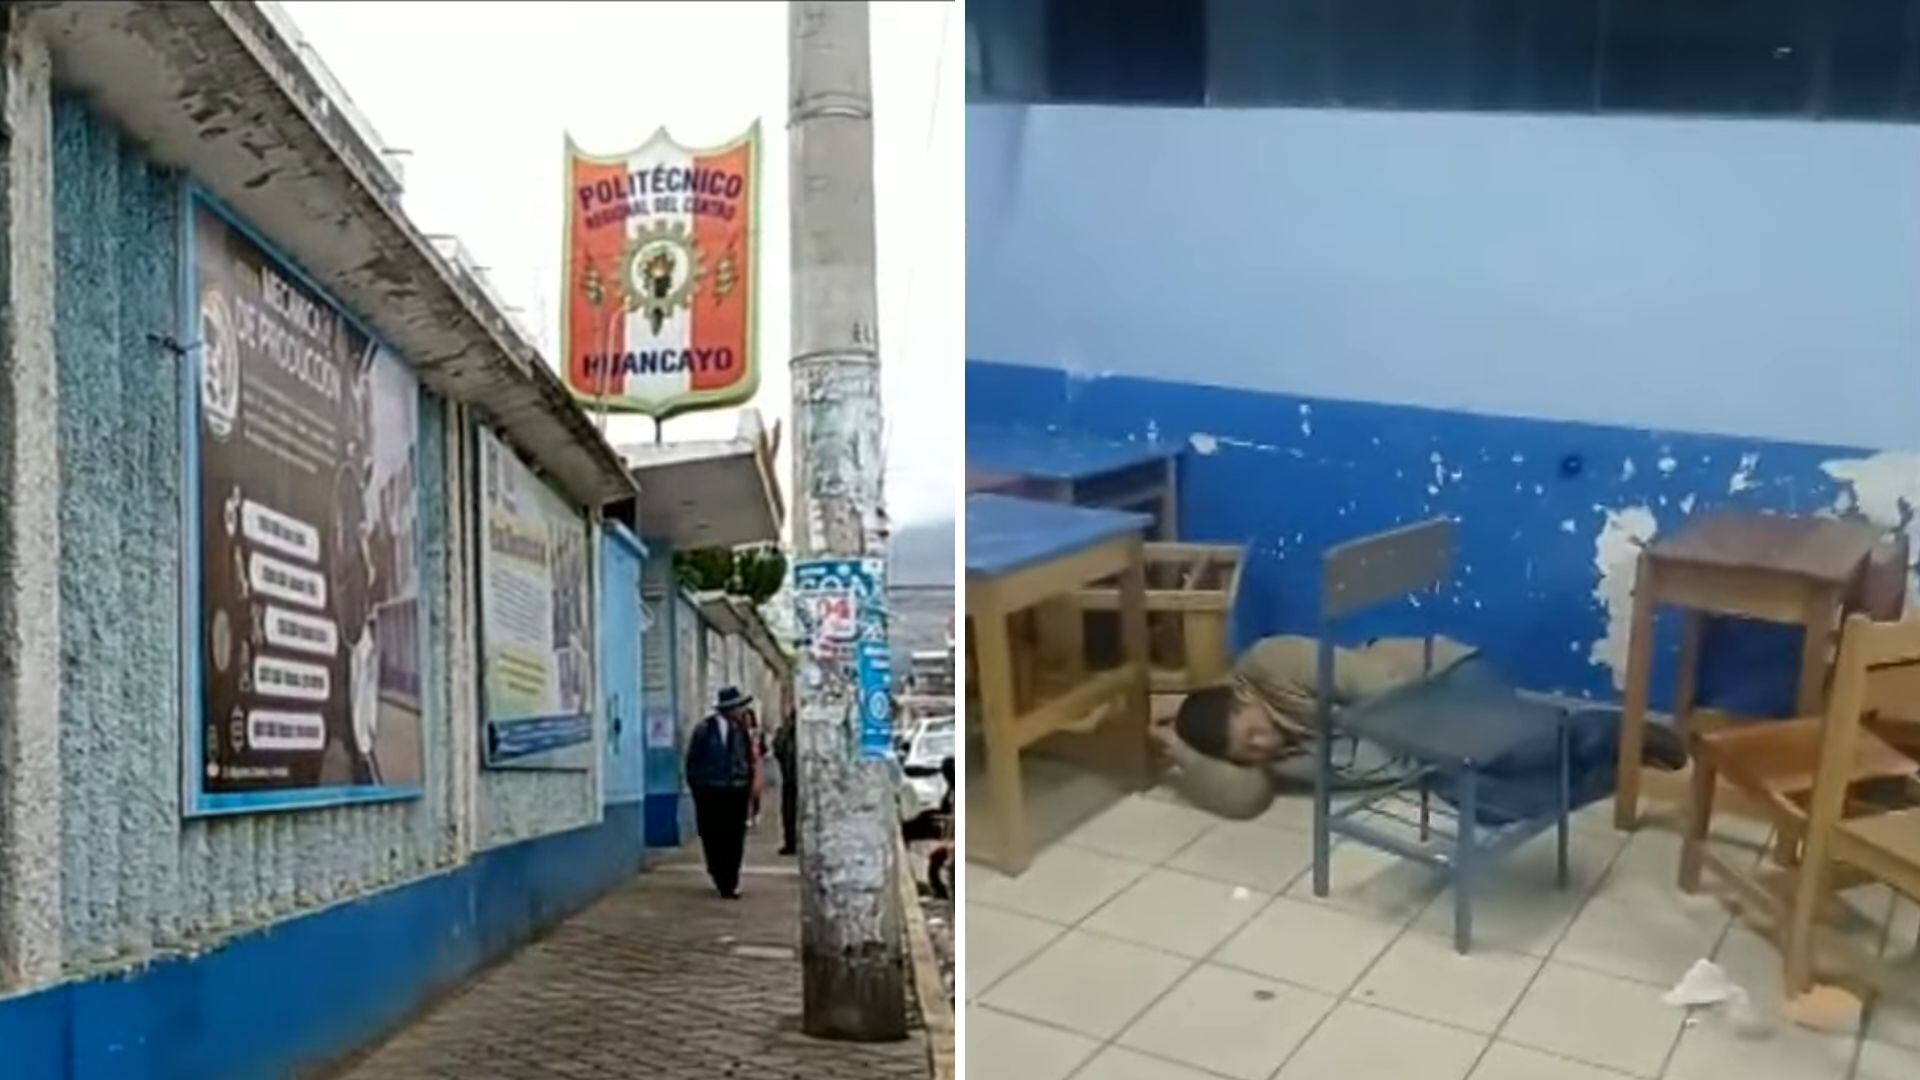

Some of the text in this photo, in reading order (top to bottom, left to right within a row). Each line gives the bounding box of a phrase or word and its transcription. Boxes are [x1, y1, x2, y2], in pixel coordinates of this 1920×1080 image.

[579, 163, 743, 211] POLITÉCNICO
[654, 196, 679, 214] DEL
[583, 346, 733, 378] HUANCAYO
